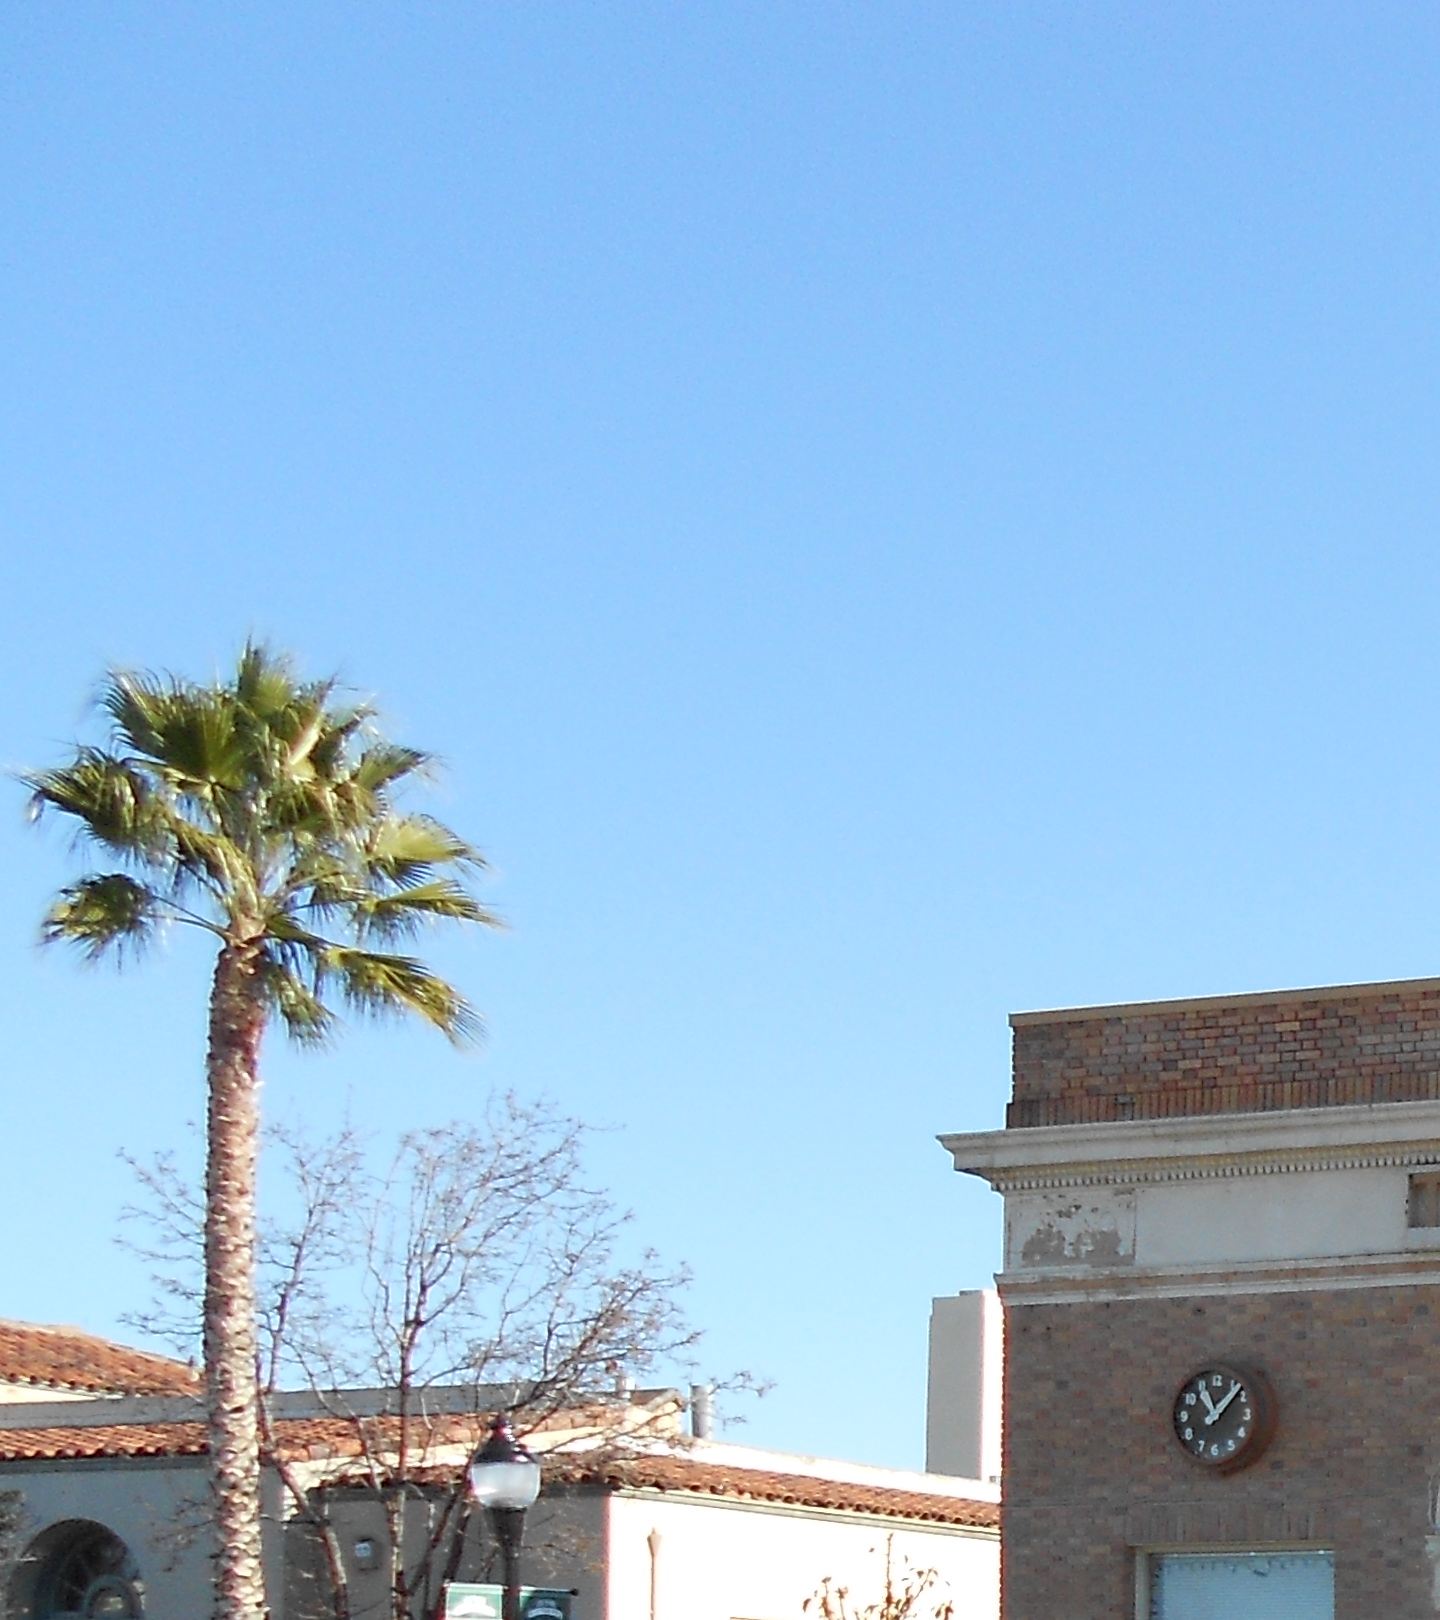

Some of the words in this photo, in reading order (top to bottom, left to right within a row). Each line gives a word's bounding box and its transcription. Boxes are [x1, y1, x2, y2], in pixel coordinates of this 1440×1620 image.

[1212, 1375, 1223, 1386] 12
[1186, 1393, 1196, 1405] 10
[1240, 1391, 1247, 1402] 2
[1180, 1411, 1188, 1422] 9
[1243, 1408, 1251, 1420] 3
[1185, 1428, 1193, 1440] 8
[1238, 1427, 1246, 1438] 4
[1198, 1440, 1205, 1452] 7
[1211, 1444, 1219, 1456] 6
[1227, 1440, 1236, 1451] 5
